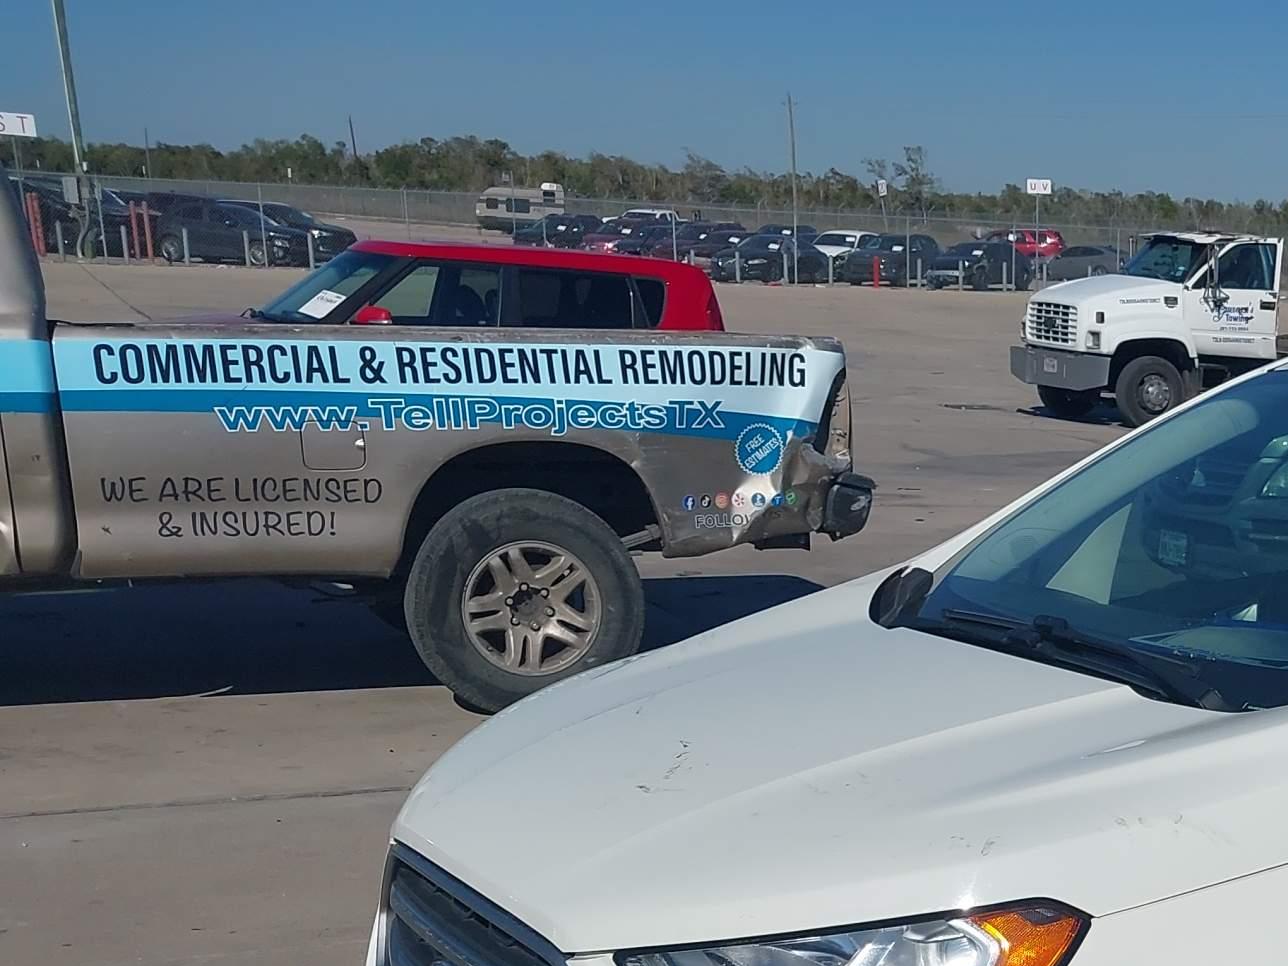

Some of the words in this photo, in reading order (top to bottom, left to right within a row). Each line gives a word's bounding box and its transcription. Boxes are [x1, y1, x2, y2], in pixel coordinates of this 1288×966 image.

[16, 115, 28, 134] T
[93, 343, 351, 385] COMMERCIAL
[359, 345, 387, 385] &
[395, 346, 613, 386] RESIDENTIAL
[618, 349, 807, 388] REMODELING
[213, 396, 727, 437] www.TellProjectsTX
[743, 436, 781, 469] ESTIMATES
[745, 433, 766, 453] FREE
[100, 476, 148, 502] WE
[159, 476, 226, 502] ARE
[234, 477, 383, 504] LICENSED
[157, 510, 185, 538] &
[191, 510, 337, 538] INSURED!
